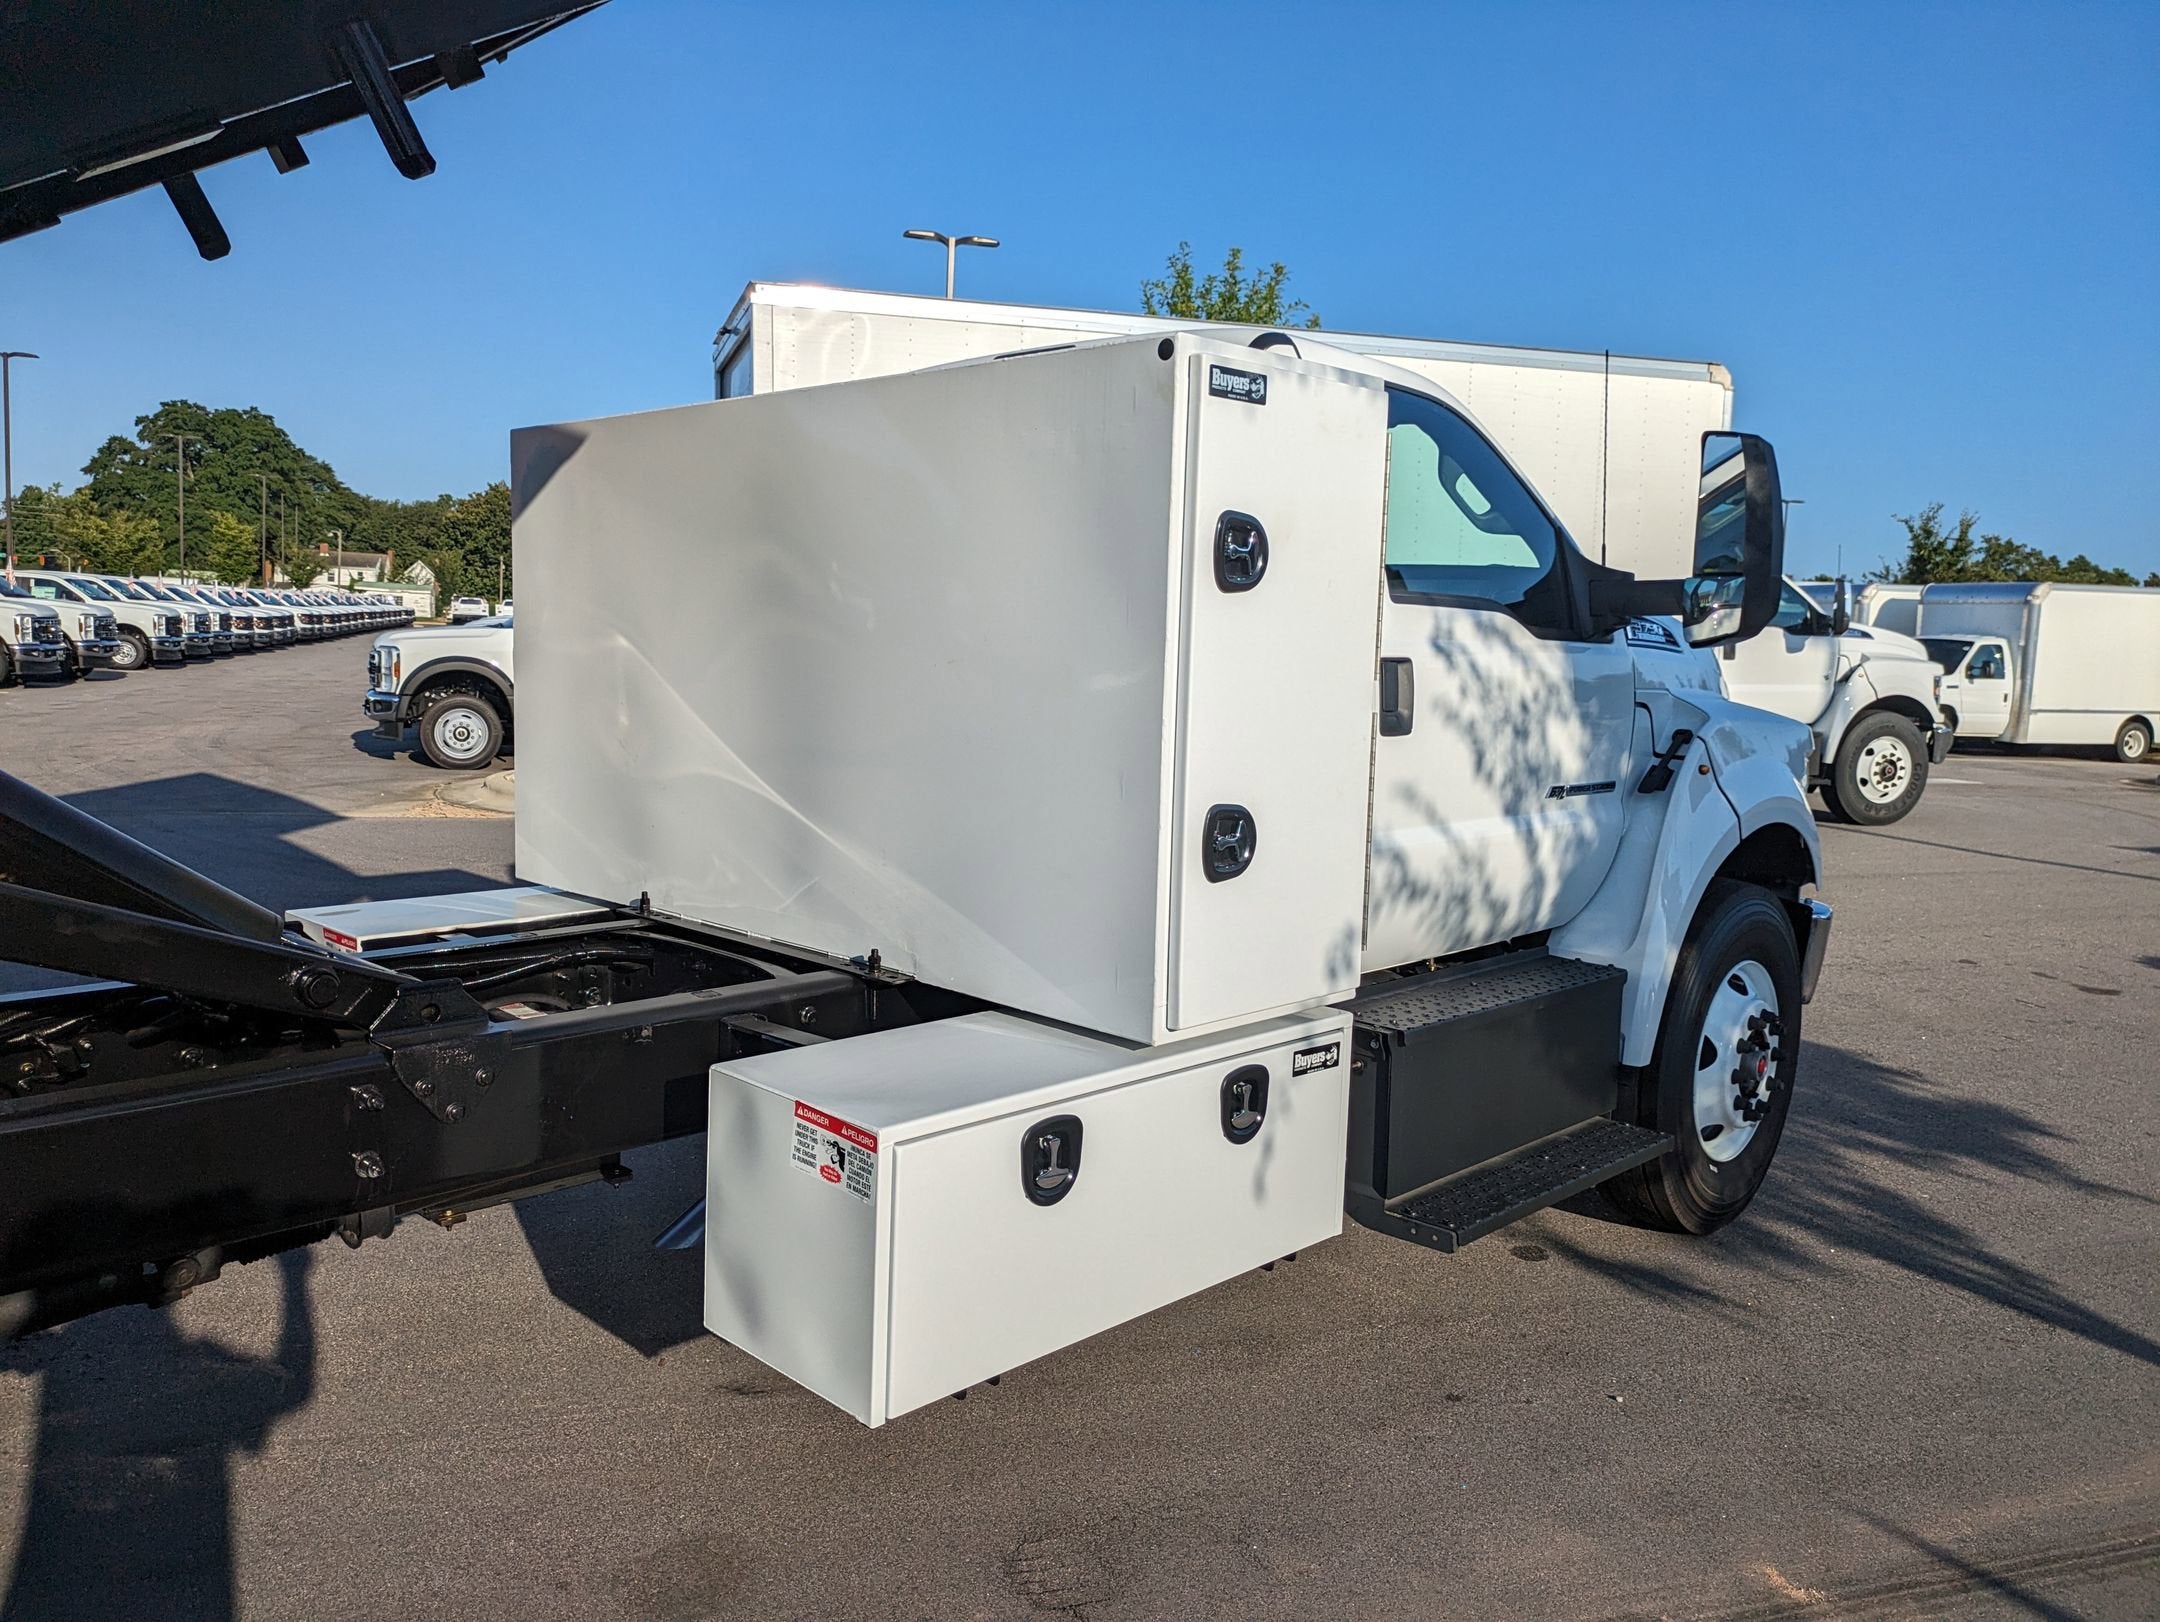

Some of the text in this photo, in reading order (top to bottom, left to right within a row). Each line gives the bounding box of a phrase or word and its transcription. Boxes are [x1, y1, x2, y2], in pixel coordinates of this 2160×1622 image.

[1212, 367, 1250, 391] Buyers
[1863, 762, 1923, 815] GOODYEAR
[1295, 1051, 1326, 1068] Buyers
[796, 1121, 810, 1133] NEVER
[803, 1108, 829, 1127] DANGER
[847, 1129, 874, 1148] PELIGRO
